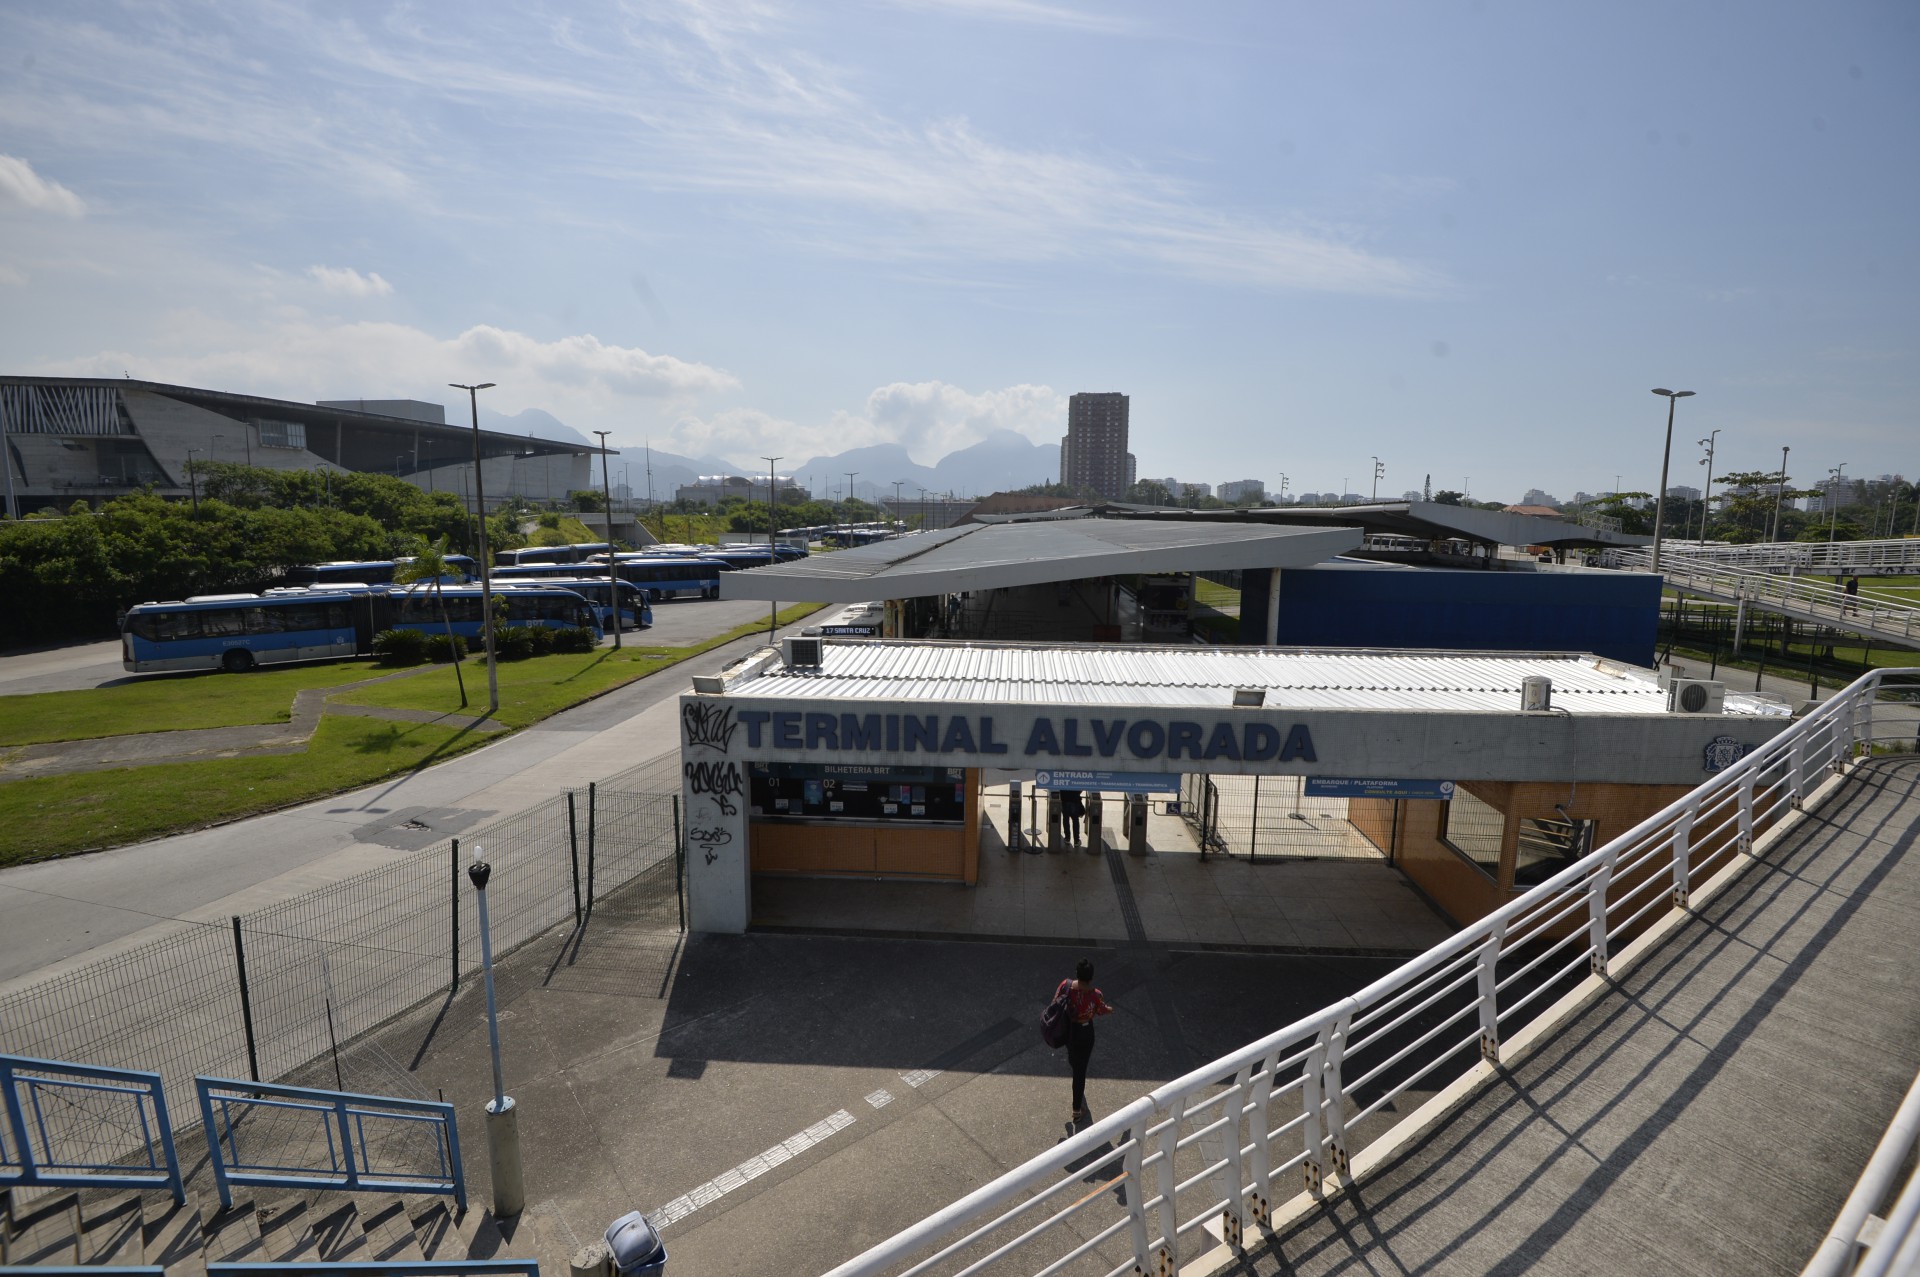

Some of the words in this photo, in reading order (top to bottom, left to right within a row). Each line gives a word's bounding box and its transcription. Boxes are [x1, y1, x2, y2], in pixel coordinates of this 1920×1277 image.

[737, 711, 1008, 754] TERMINAL
[1024, 717, 1318, 762] ALVORADA
[824, 765, 872, 774] BILHETERIA
[873, 766, 891, 775] BRT
[947, 767, 964, 775] BRT
[1053, 771, 1094, 779] ENTRADA
[768, 777, 780, 788] 01
[823, 779, 836, 789] 02
